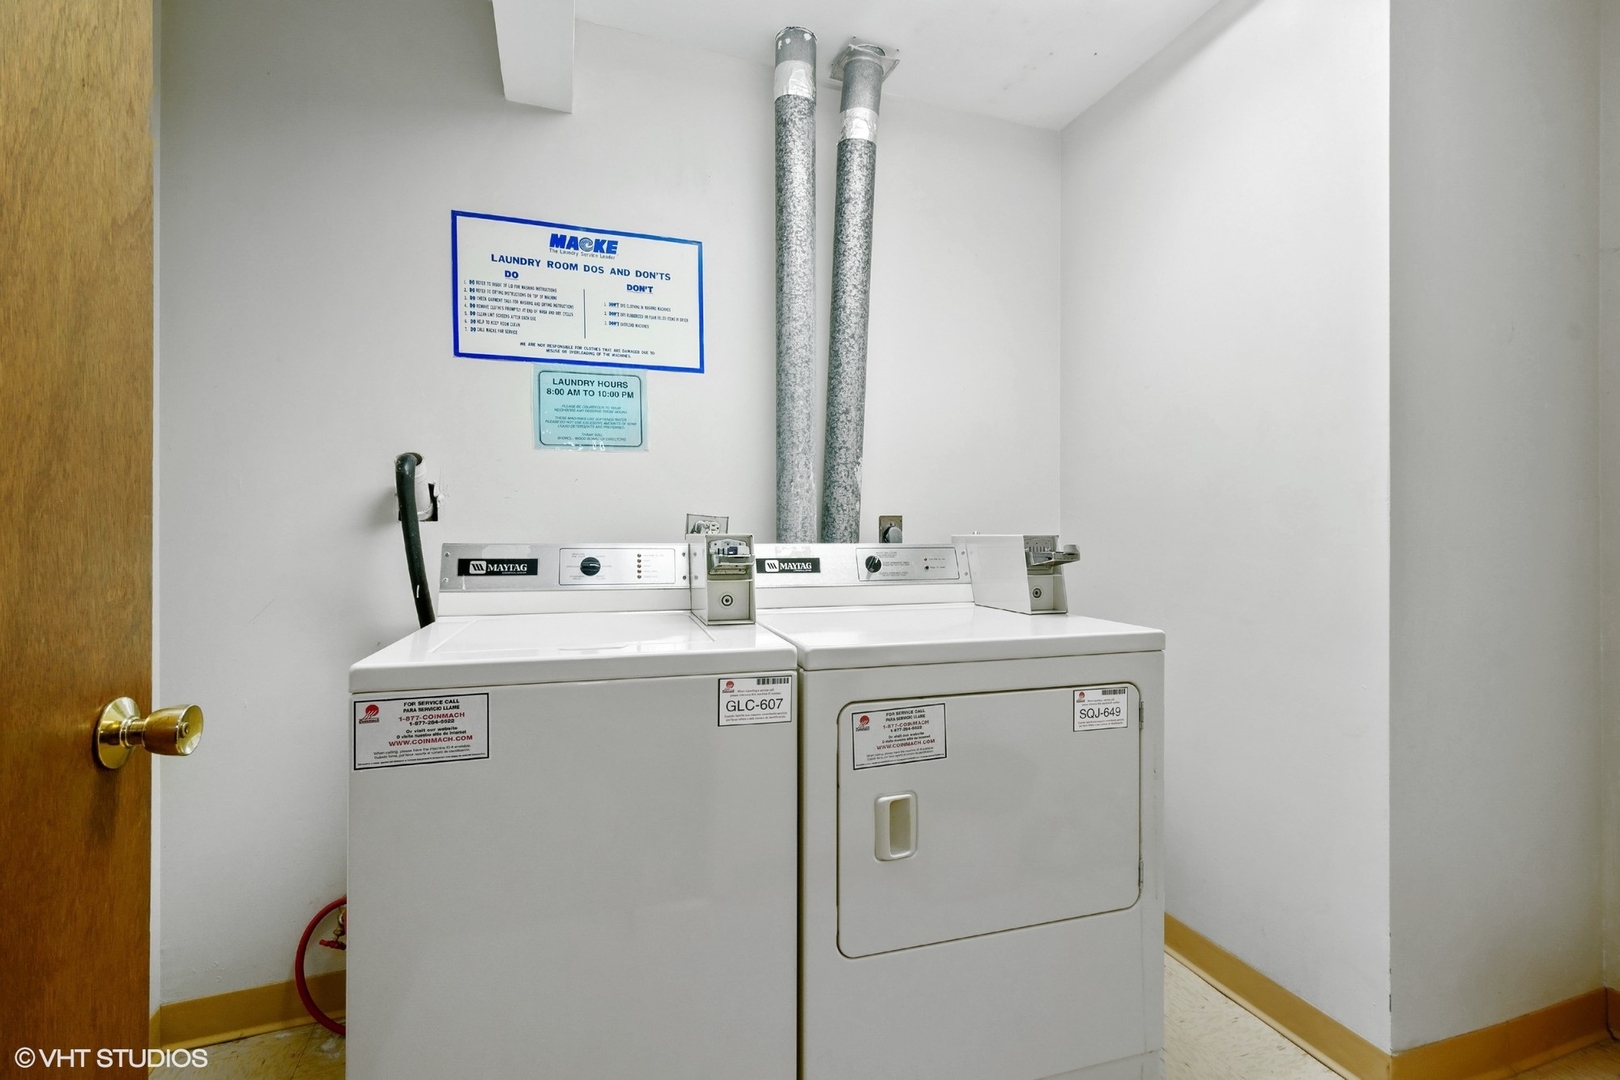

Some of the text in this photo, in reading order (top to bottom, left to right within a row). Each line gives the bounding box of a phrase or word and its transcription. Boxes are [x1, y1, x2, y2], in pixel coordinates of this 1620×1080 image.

[550, 233, 618, 254] MACKE
[491, 253, 671, 281] LAUNDRY ROOM DOS AND DON'TS
[504, 270, 519, 279] DO
[626, 284, 653, 293] DON'T
[553, 378, 628, 388] LAUNDRY HOURS
[726, 698, 783, 712] GLC-607
[399, 712, 465, 721] 1-877-COINMACH
[1080, 707, 1121, 719] SQJ-649
[389, 735, 473, 746] WWW.COINMACH.COM
